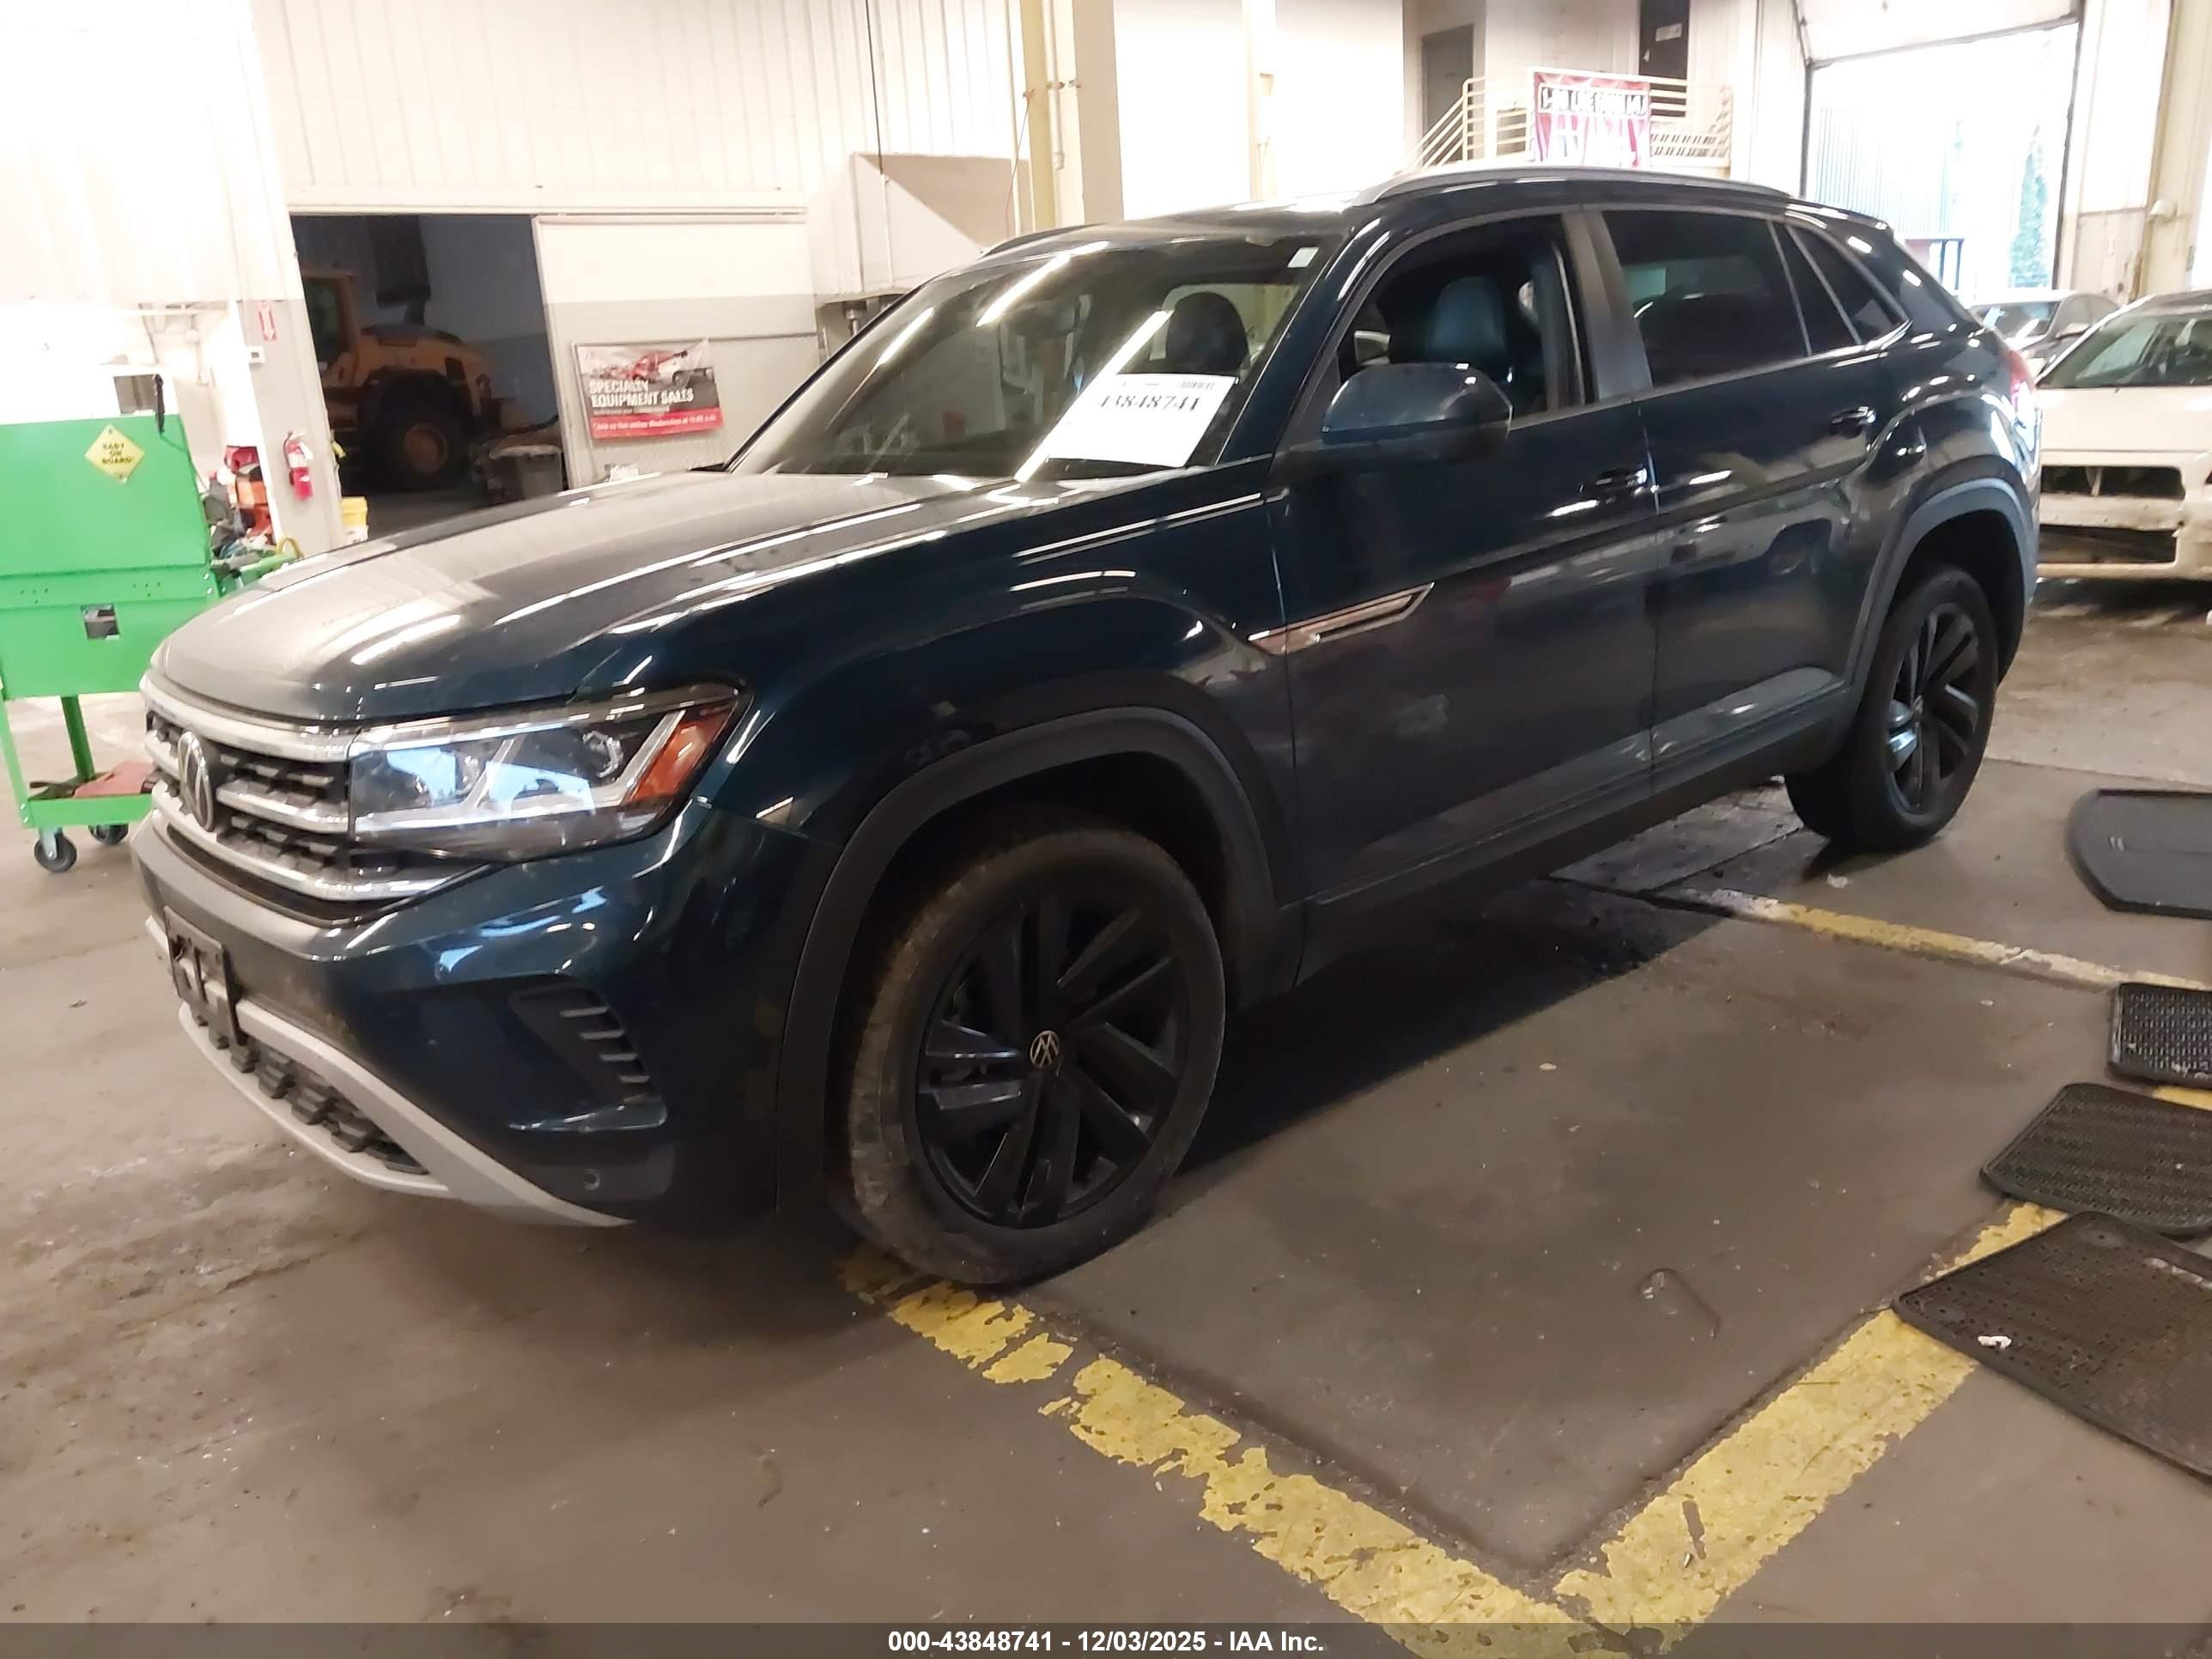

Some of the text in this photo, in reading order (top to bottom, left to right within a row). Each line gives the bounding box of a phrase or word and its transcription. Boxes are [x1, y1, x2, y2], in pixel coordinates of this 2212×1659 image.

[589, 379, 648, 392] SPECIALTY
[591, 387, 694, 408] EQUIPMENT SALES
